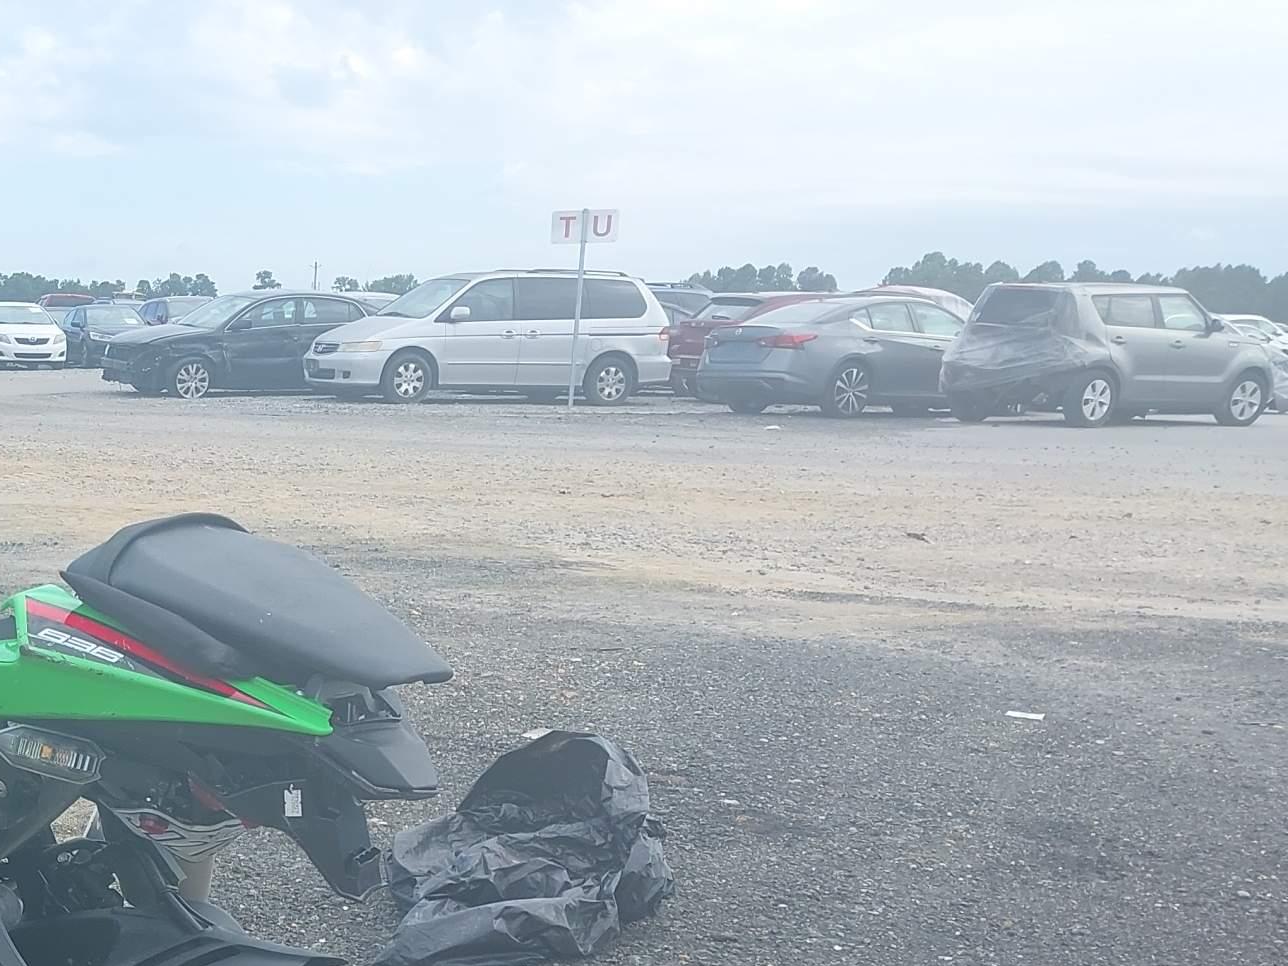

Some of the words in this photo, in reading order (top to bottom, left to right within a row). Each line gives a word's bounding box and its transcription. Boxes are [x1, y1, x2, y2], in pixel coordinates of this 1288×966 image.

[559, 215, 577, 238] T
[592, 214, 613, 237] U
[37, 627, 125, 663] 636
